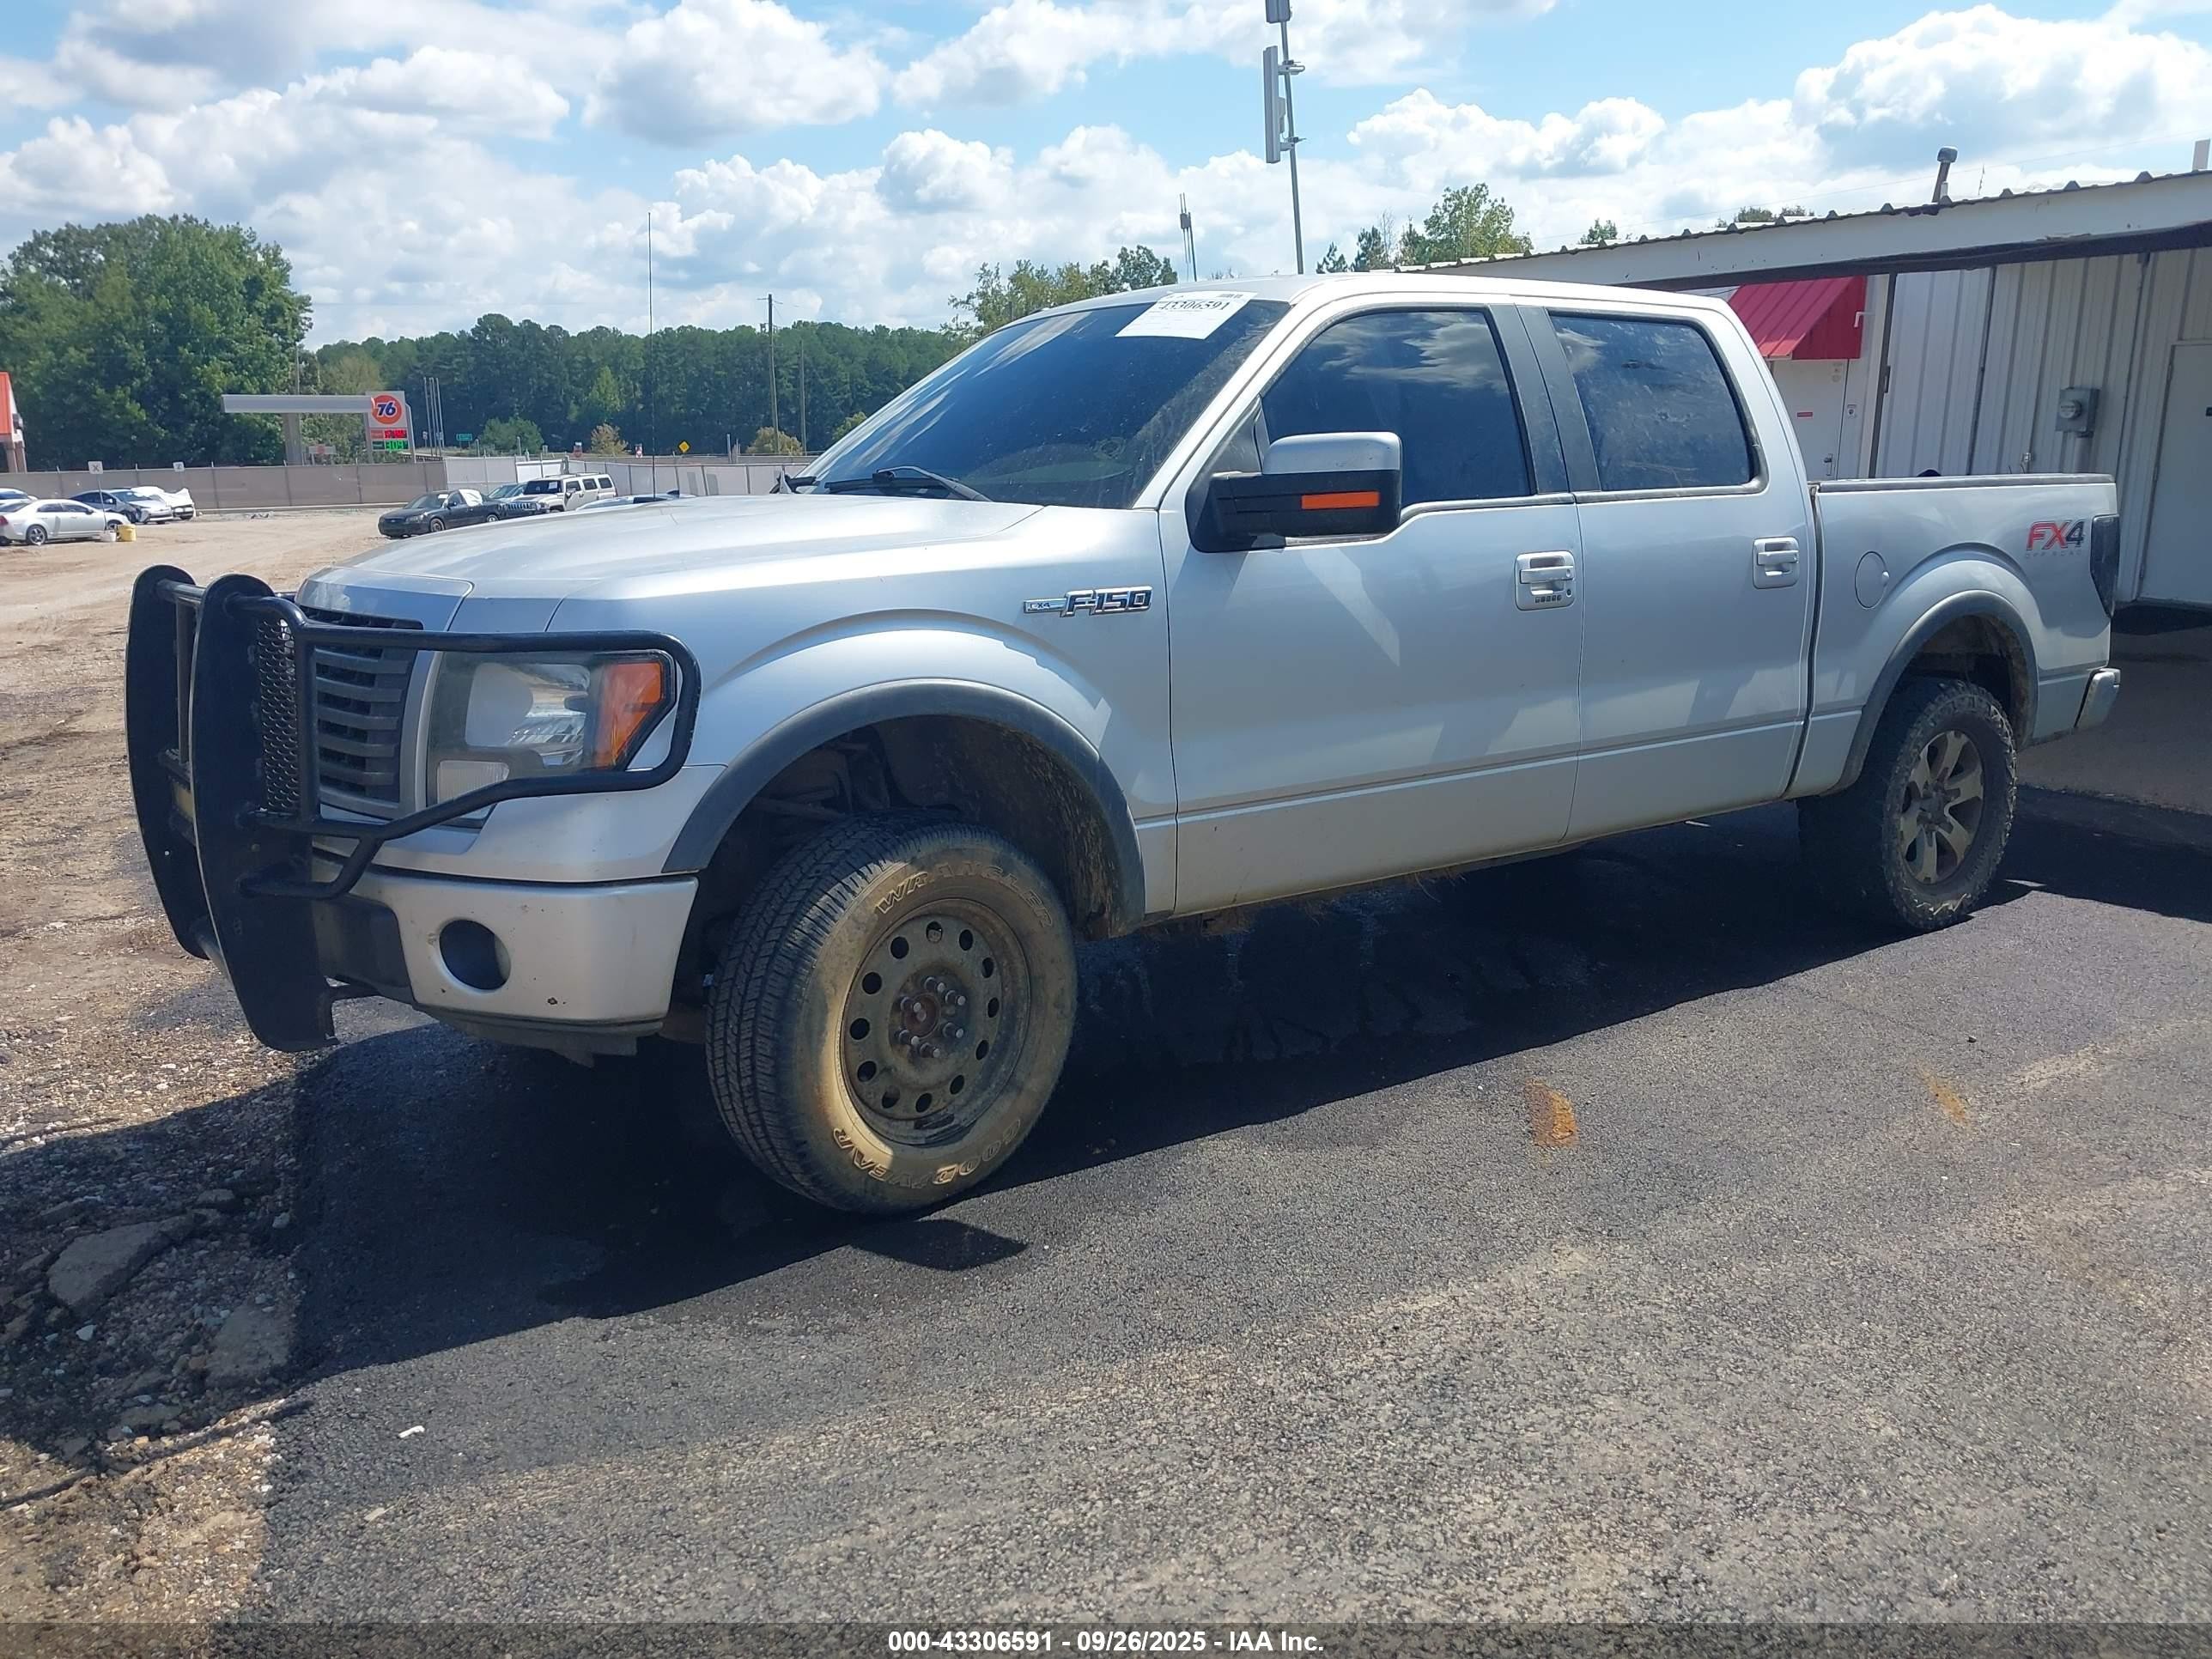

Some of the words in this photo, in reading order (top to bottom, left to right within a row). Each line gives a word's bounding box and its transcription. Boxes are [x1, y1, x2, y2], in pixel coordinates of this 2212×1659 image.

[377, 401, 397, 417] 76
[2027, 519, 2085, 550] FX4
[1060, 586, 1153, 617] F-150
